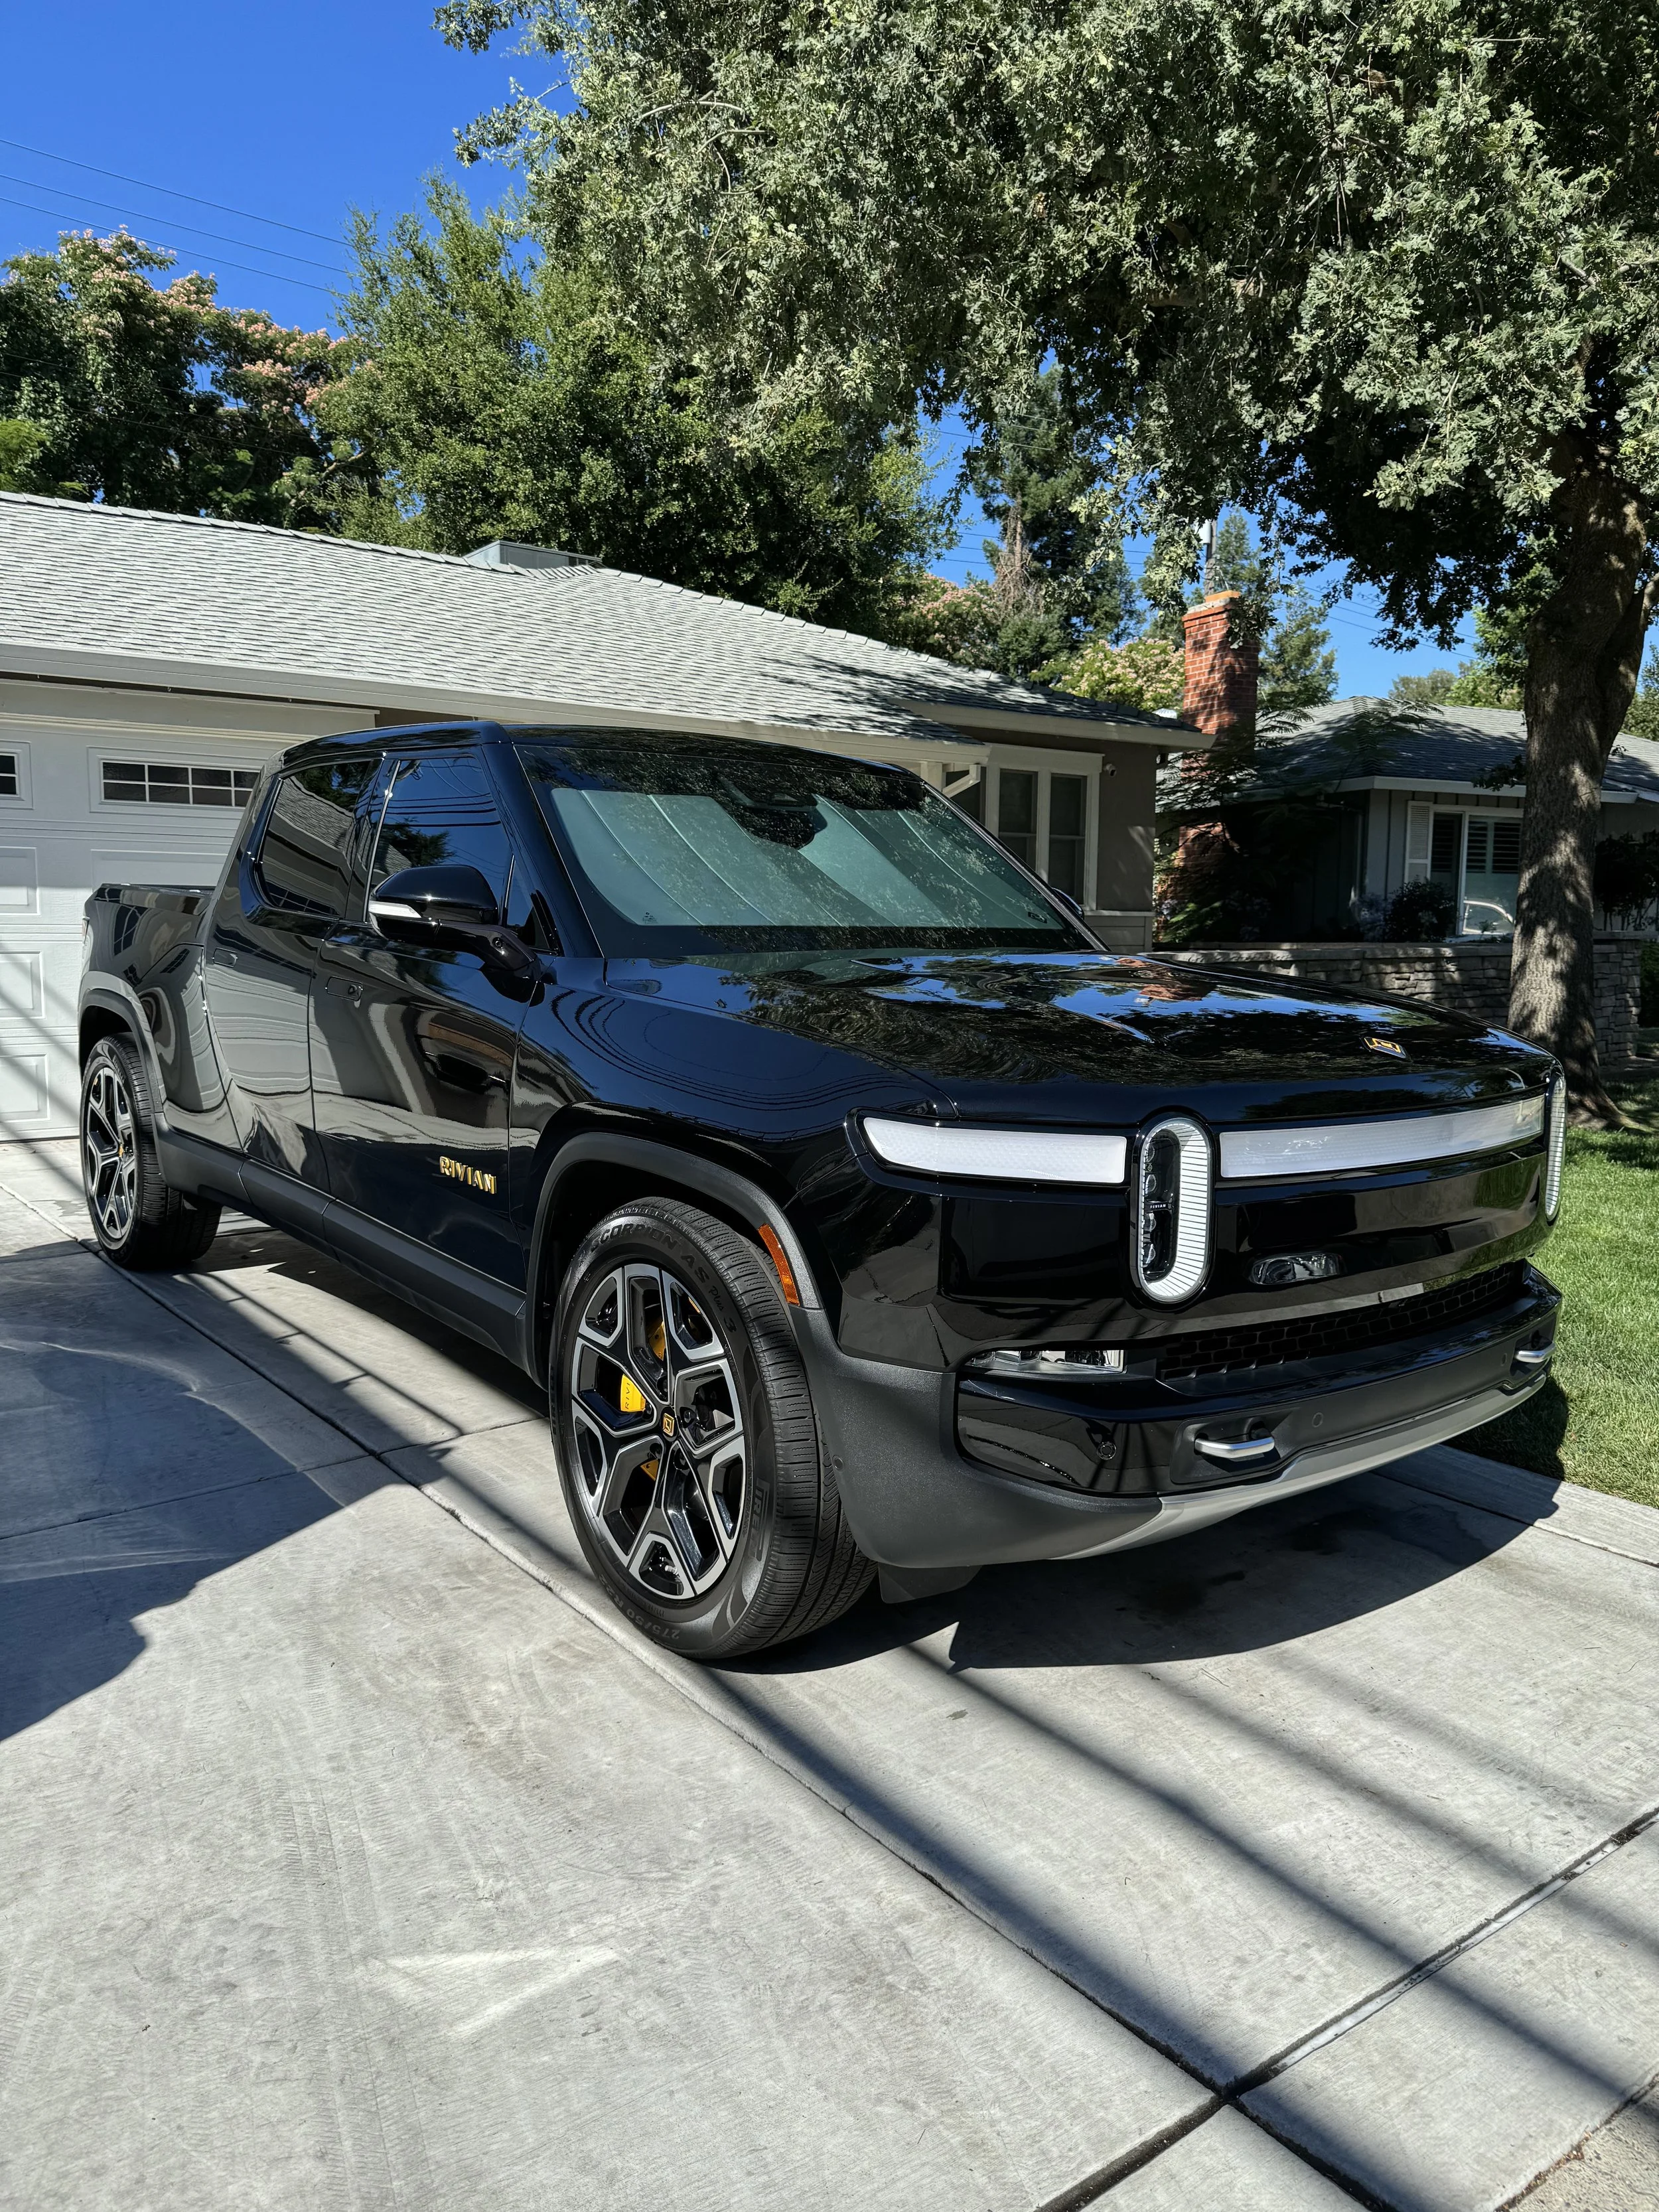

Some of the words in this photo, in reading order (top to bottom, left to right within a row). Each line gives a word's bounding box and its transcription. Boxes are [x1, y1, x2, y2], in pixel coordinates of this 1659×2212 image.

[439, 1155, 496, 1195] RIVIAN
[590, 1222, 680, 1253] SCORPION
[681, 1254, 711, 1284] AS
[708, 1285, 725, 1313] Plus
[723, 1316, 738, 1333] 3
[626, 1607, 681, 1640] 275/50
